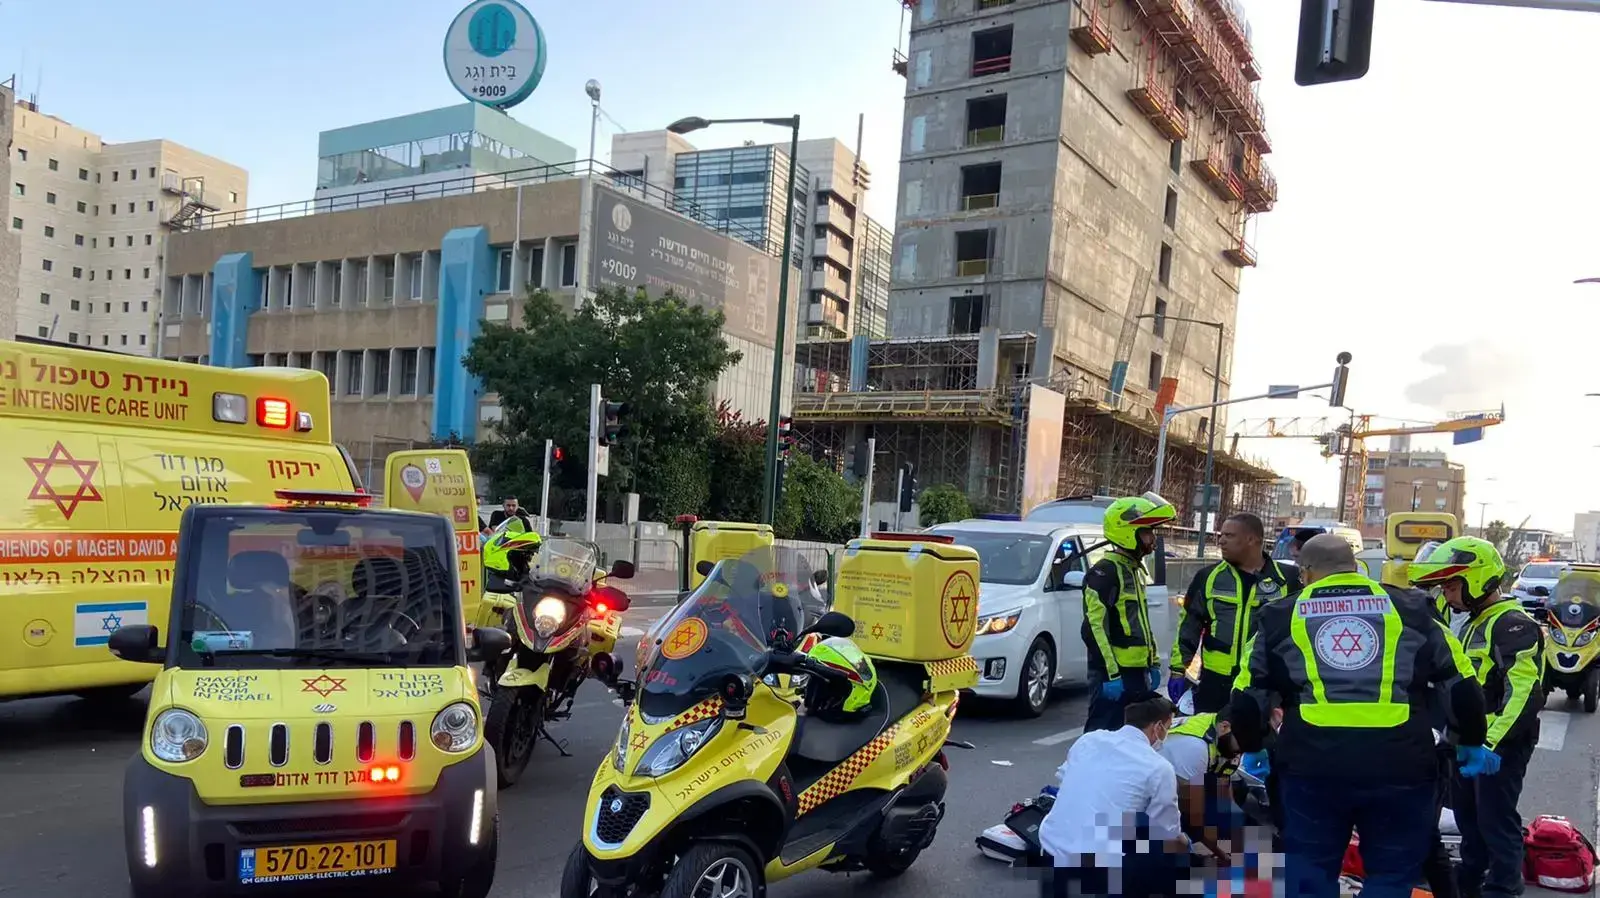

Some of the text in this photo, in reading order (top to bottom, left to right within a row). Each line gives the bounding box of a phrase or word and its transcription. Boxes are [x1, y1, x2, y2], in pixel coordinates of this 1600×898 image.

[659, 236, 688, 257] חדשה
[690, 247, 710, 264] חיים
[30, 357, 110, 390] טיפול
[123, 372, 189, 398] ניידת
[12, 387, 101, 413] INTENSIVE
[106, 397, 149, 418] CARE
[154, 402, 189, 421] UNIT
[153, 454, 225, 474] מגן דוד
[267, 459, 321, 480] ירקון
[181, 475, 228, 492] אדום
[53, 539, 73, 557] OF
[77, 539, 125, 557] MAGEN
[129, 539, 166, 556] DAVID
[72, 567, 145, 584] ההצלה
[1300, 597, 1388, 615] יחידת האופנועים
[196, 675, 258, 683] MAGEN
[376, 673, 441, 682] מגן דוד
[399, 680, 443, 689] אדום
[193, 691, 273, 701] IN ISRAEL
[194, 687, 249, 695] ADOM
[372, 687, 443, 698] בישראל
[675, 729, 782, 800] מגן דוד אדום בישראל
[276, 770, 366, 787] מגן דוד אדום
[254, 875, 280, 884] GREEN
[350, 869, 366, 877] CAR
